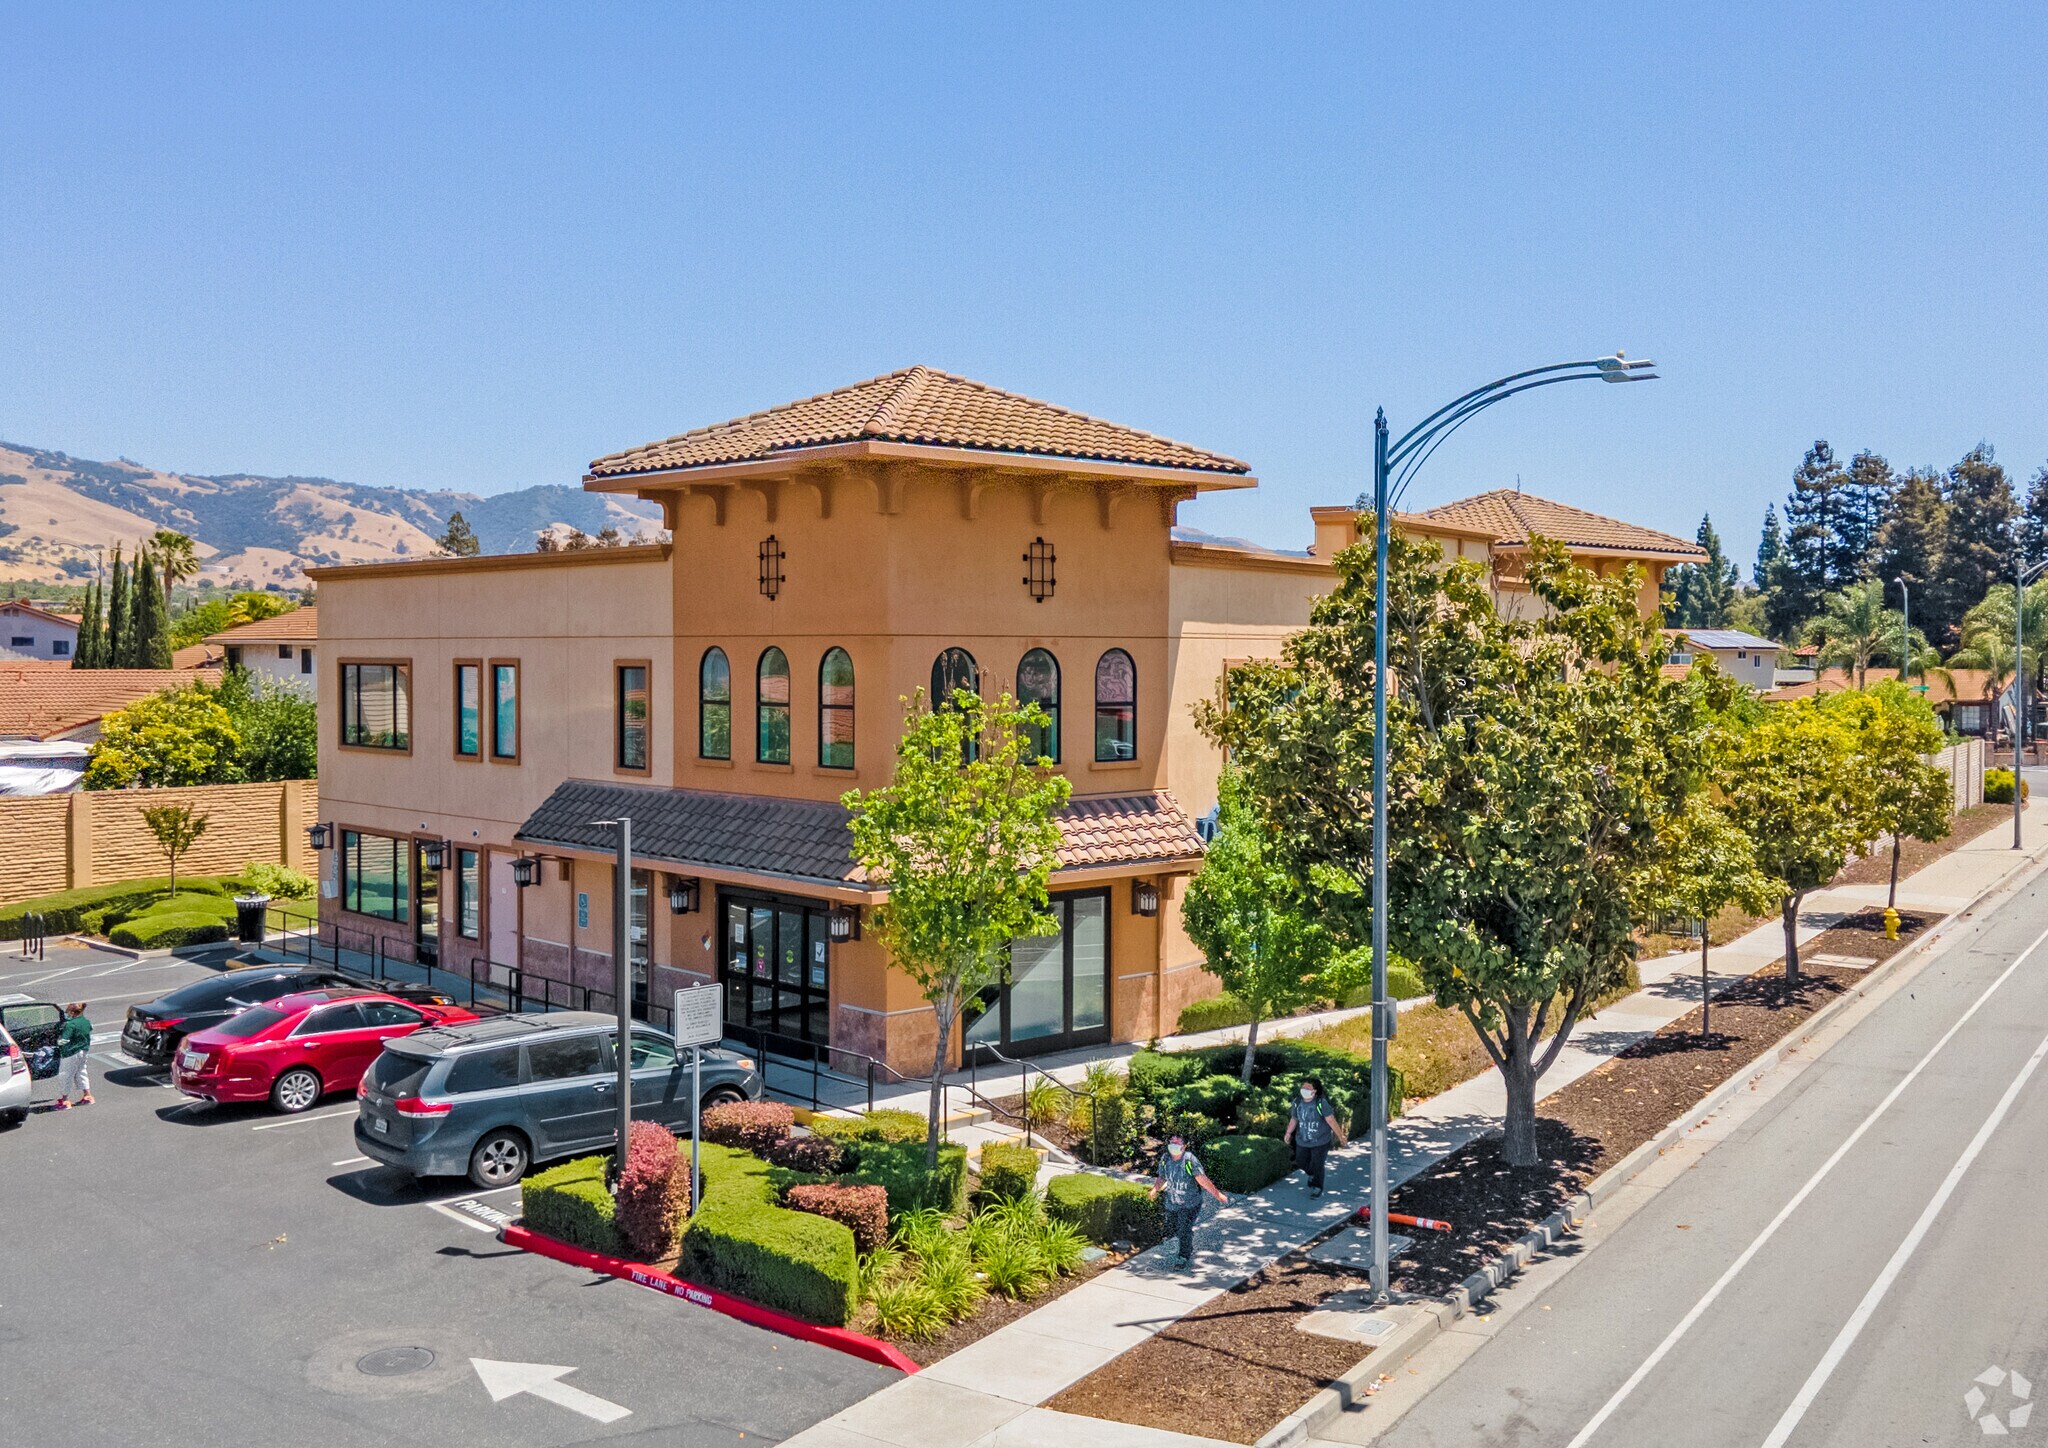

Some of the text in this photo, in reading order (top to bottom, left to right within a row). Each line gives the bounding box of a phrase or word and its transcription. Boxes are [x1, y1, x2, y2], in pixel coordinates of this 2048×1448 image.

[455, 1200, 508, 1224] PARKIN
[632, 1271, 713, 1305] FIRE LANE NO PARKING
